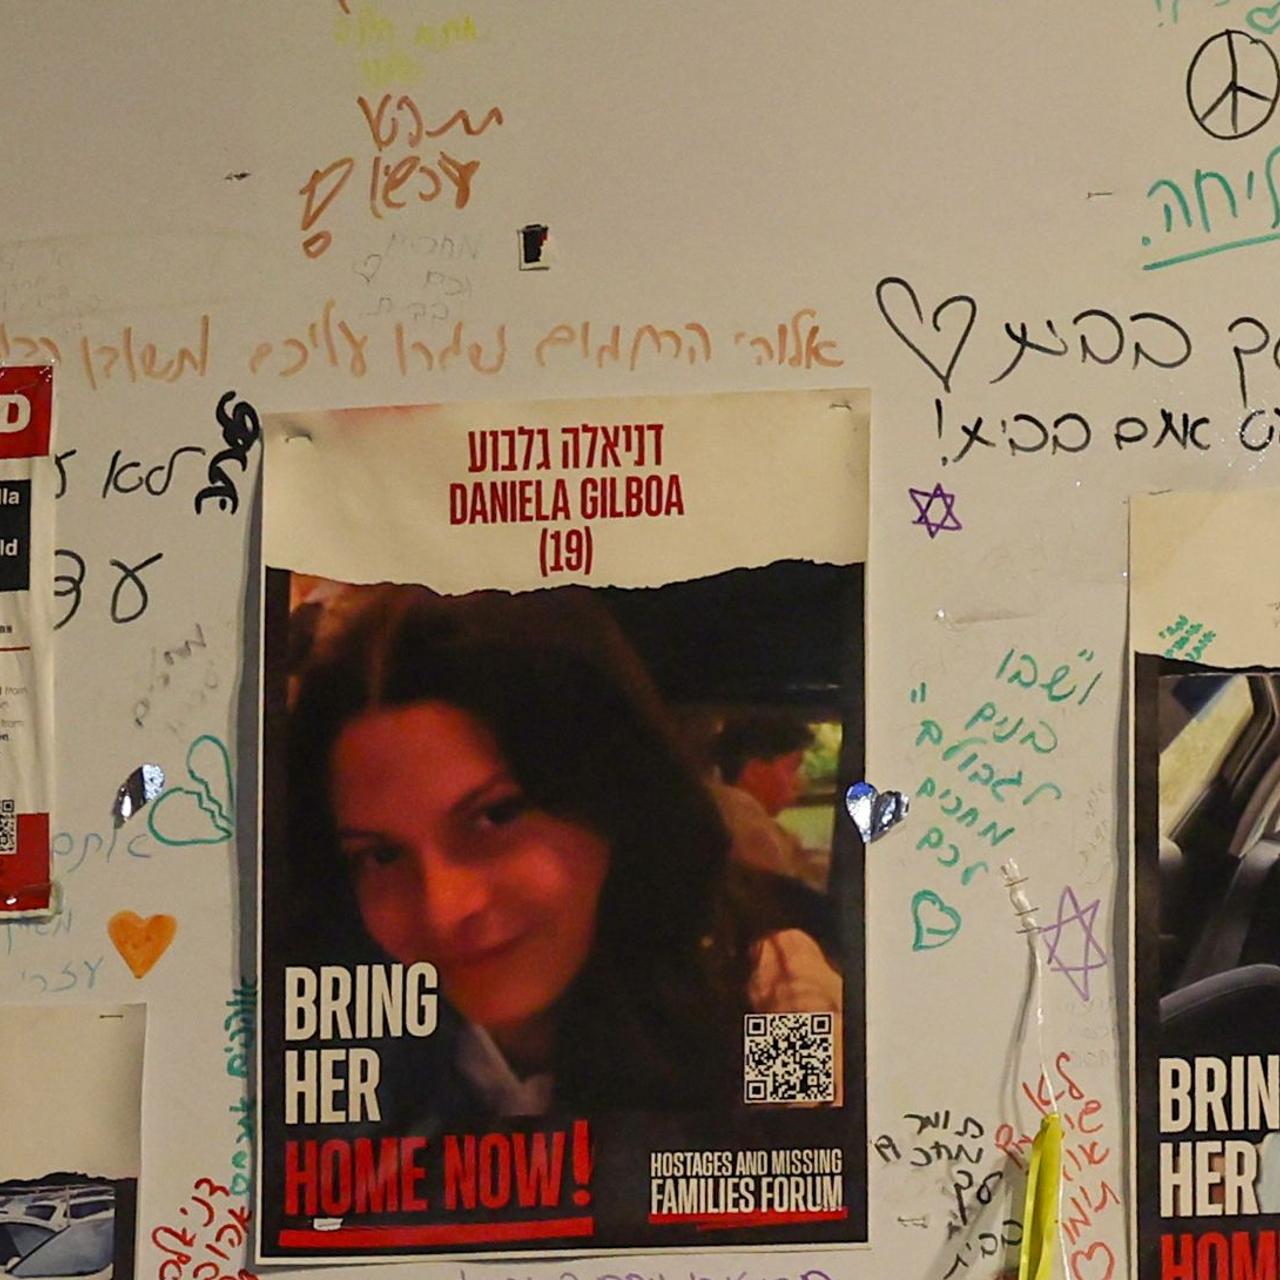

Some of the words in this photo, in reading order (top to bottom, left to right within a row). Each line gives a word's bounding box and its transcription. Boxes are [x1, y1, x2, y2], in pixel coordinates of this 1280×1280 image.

[468, 427, 551, 474] גלבוע
[562, 423, 664, 468] דניאלה
[449, 479, 571, 525] DANIELA
[580, 474, 685, 521] GILBOA
[540, 528, 593, 575] (19)
[286, 963, 437, 1040] BRING
[286, 1049, 380, 1123] HER
[285, 1137, 427, 1215] HOME
[445, 1120, 592, 1209] NOW!
[651, 1152, 732, 1176] HOSTAGES
[736, 1152, 767, 1175] AND
[772, 1149, 841, 1174] MISSING
[1161, 1141, 1258, 1217] HER
[652, 1178, 754, 1214] FAMILIES
[762, 1176, 842, 1212] FORUM
